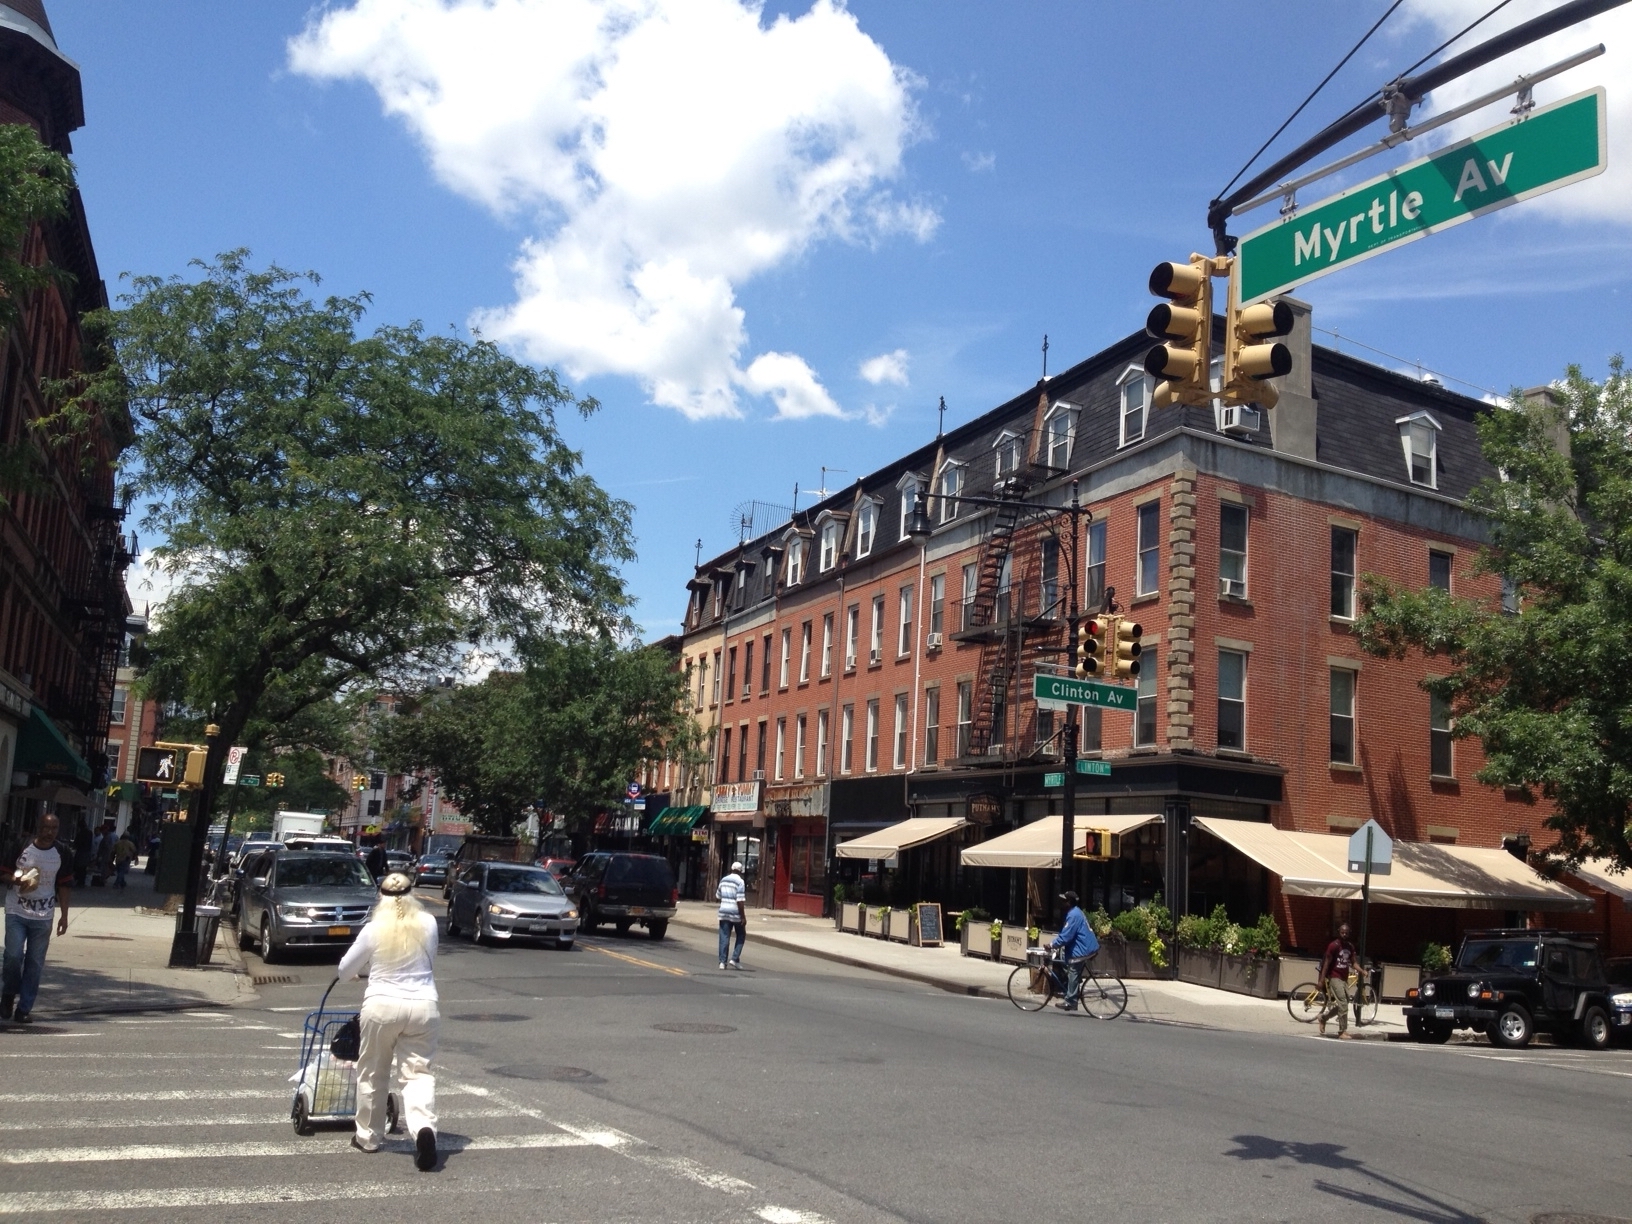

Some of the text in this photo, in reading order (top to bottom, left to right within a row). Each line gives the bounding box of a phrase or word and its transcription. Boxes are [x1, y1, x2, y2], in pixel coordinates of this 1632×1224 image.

[1294, 152, 1514, 266] Myrtle Av
[1052, 683, 1124, 704] Clinton Av
[1077, 761, 1104, 773] CLINTON
